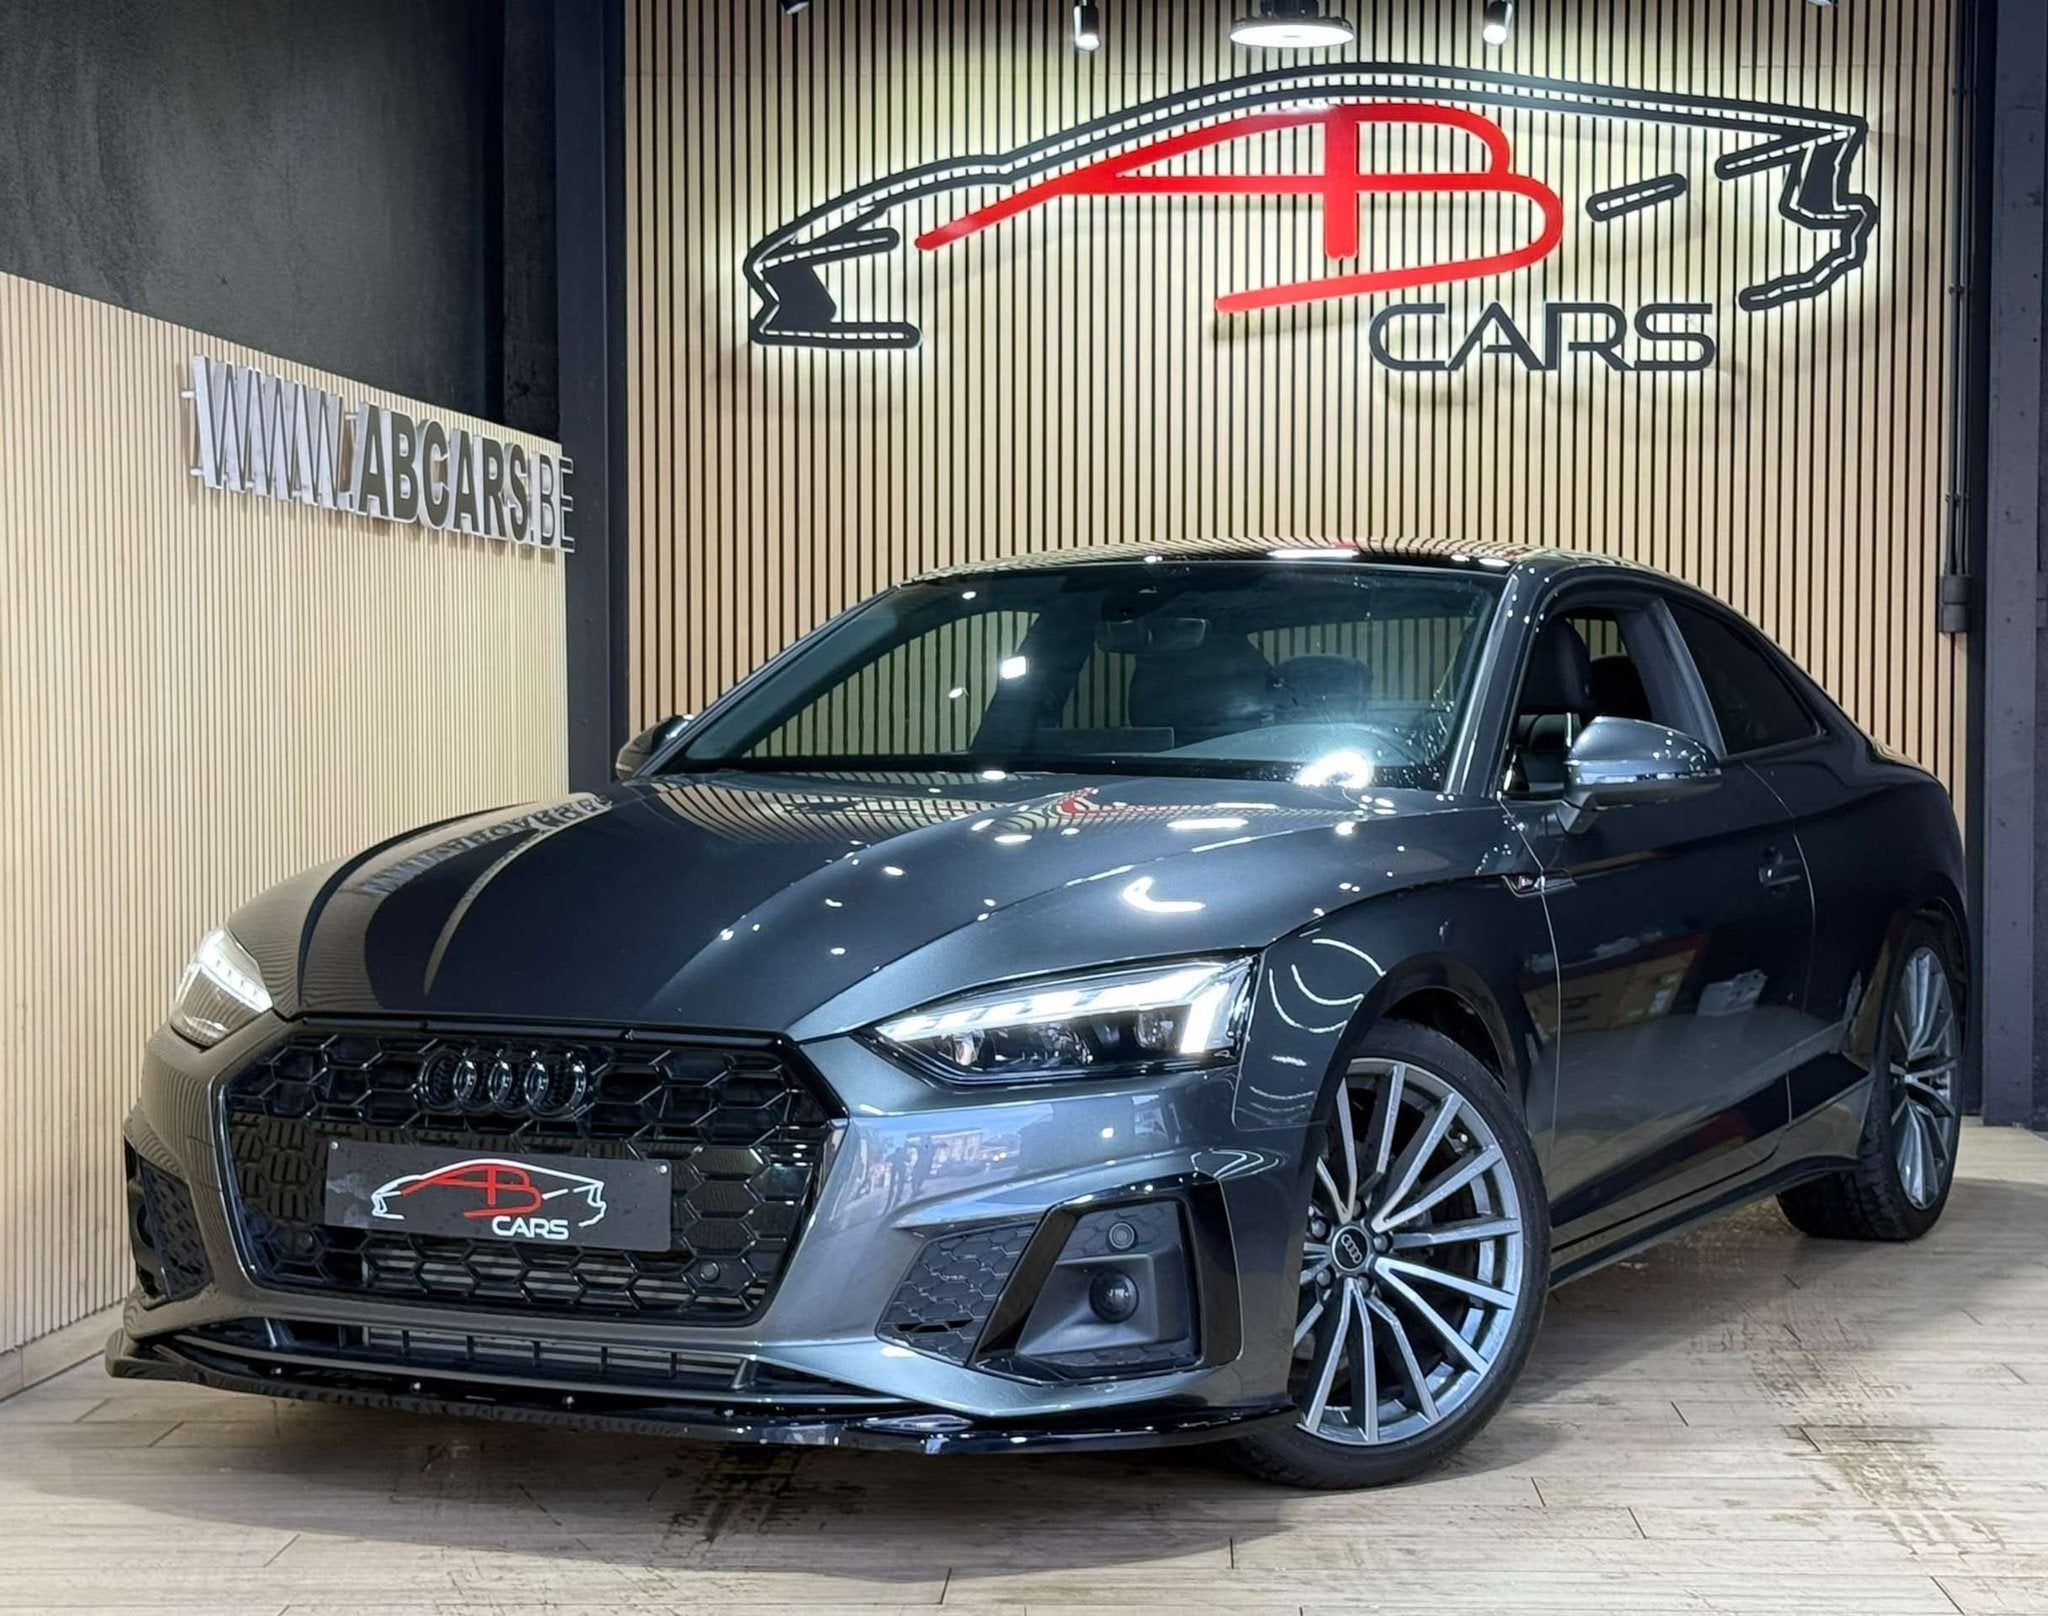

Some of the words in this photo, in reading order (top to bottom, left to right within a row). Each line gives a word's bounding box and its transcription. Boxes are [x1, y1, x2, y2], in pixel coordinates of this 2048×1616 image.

[1369, 302, 1717, 373] CARS
[191, 354, 575, 553] WWW.ABCARS.BE
[491, 1215, 569, 1240] CARS
